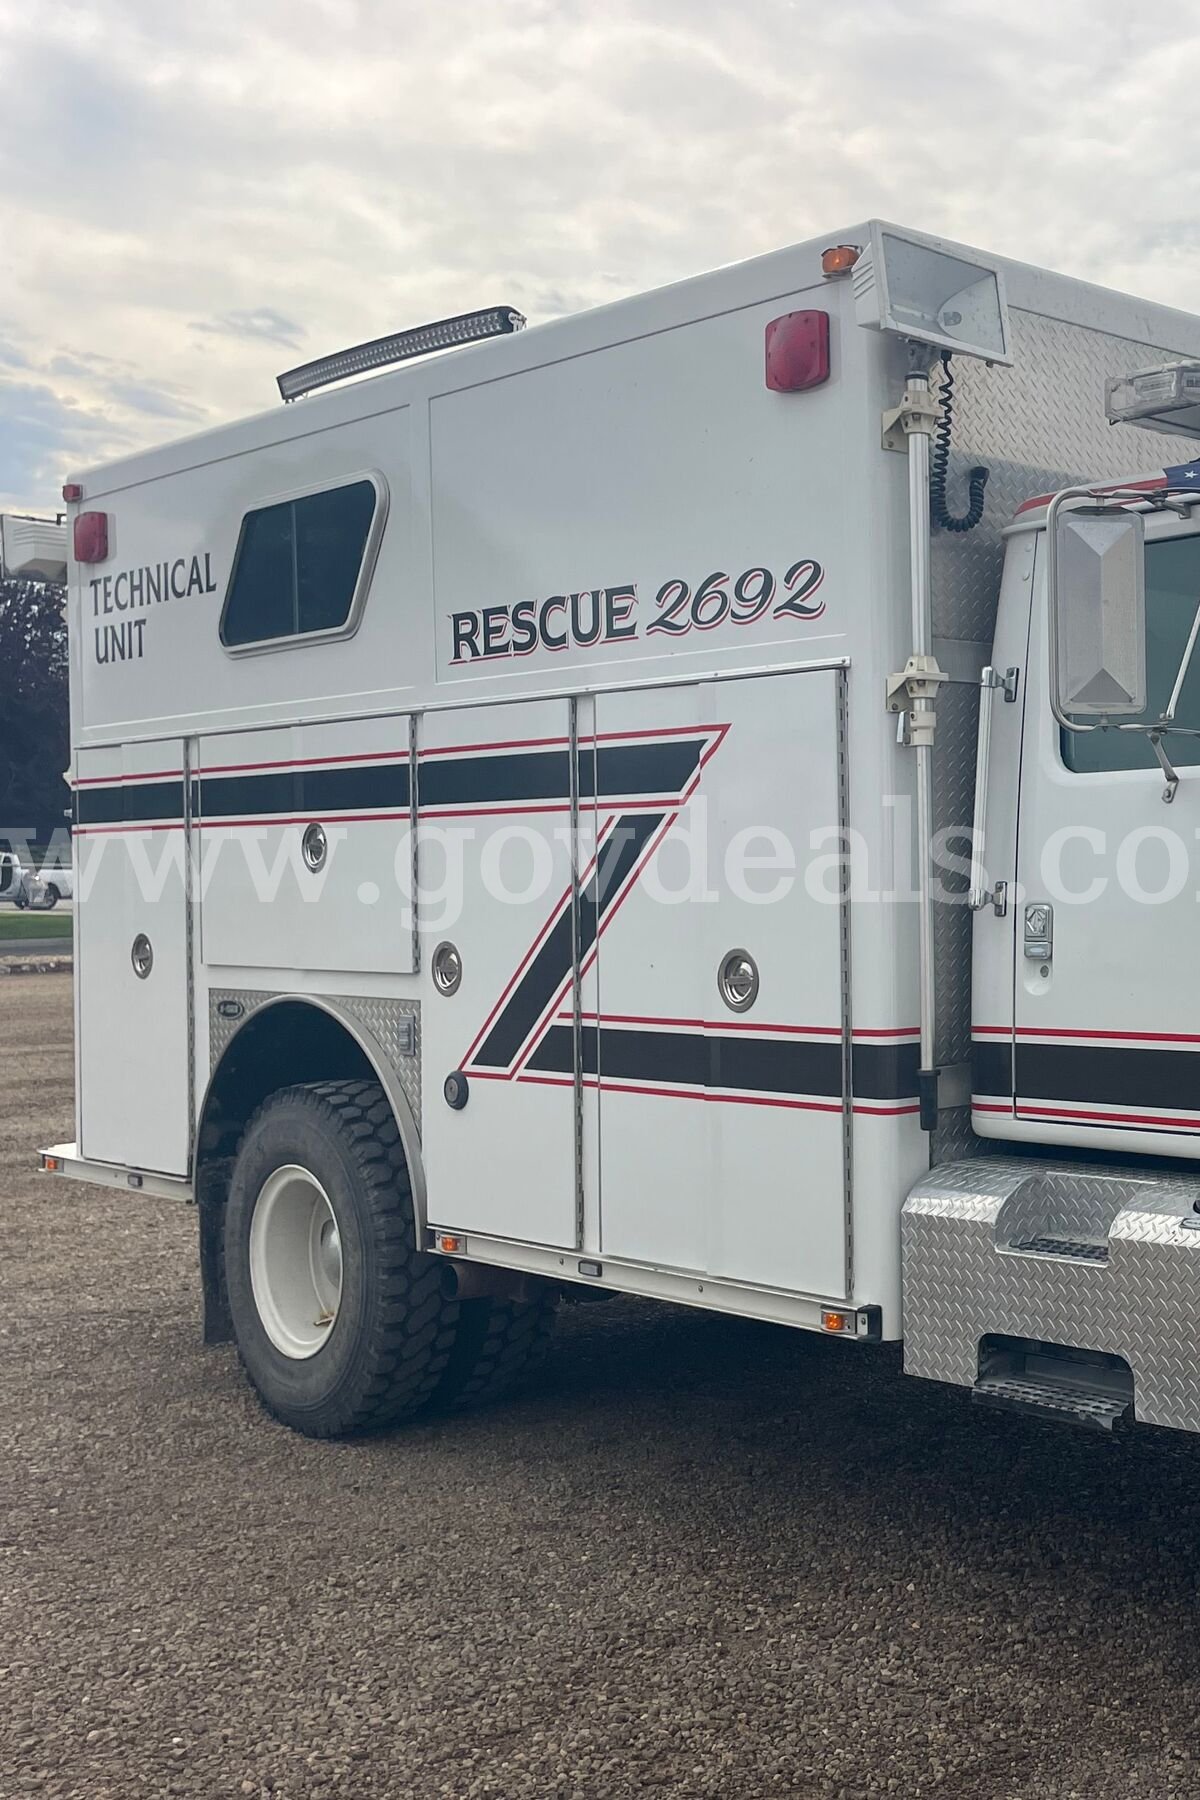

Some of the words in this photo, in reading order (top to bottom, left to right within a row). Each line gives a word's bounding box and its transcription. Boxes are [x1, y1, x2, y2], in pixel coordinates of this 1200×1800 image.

[90, 552, 217, 616] TECHNICAL
[447, 584, 639, 665] RESCUE
[646, 559, 826, 637] 2692
[95, 619, 147, 664] UNIT
